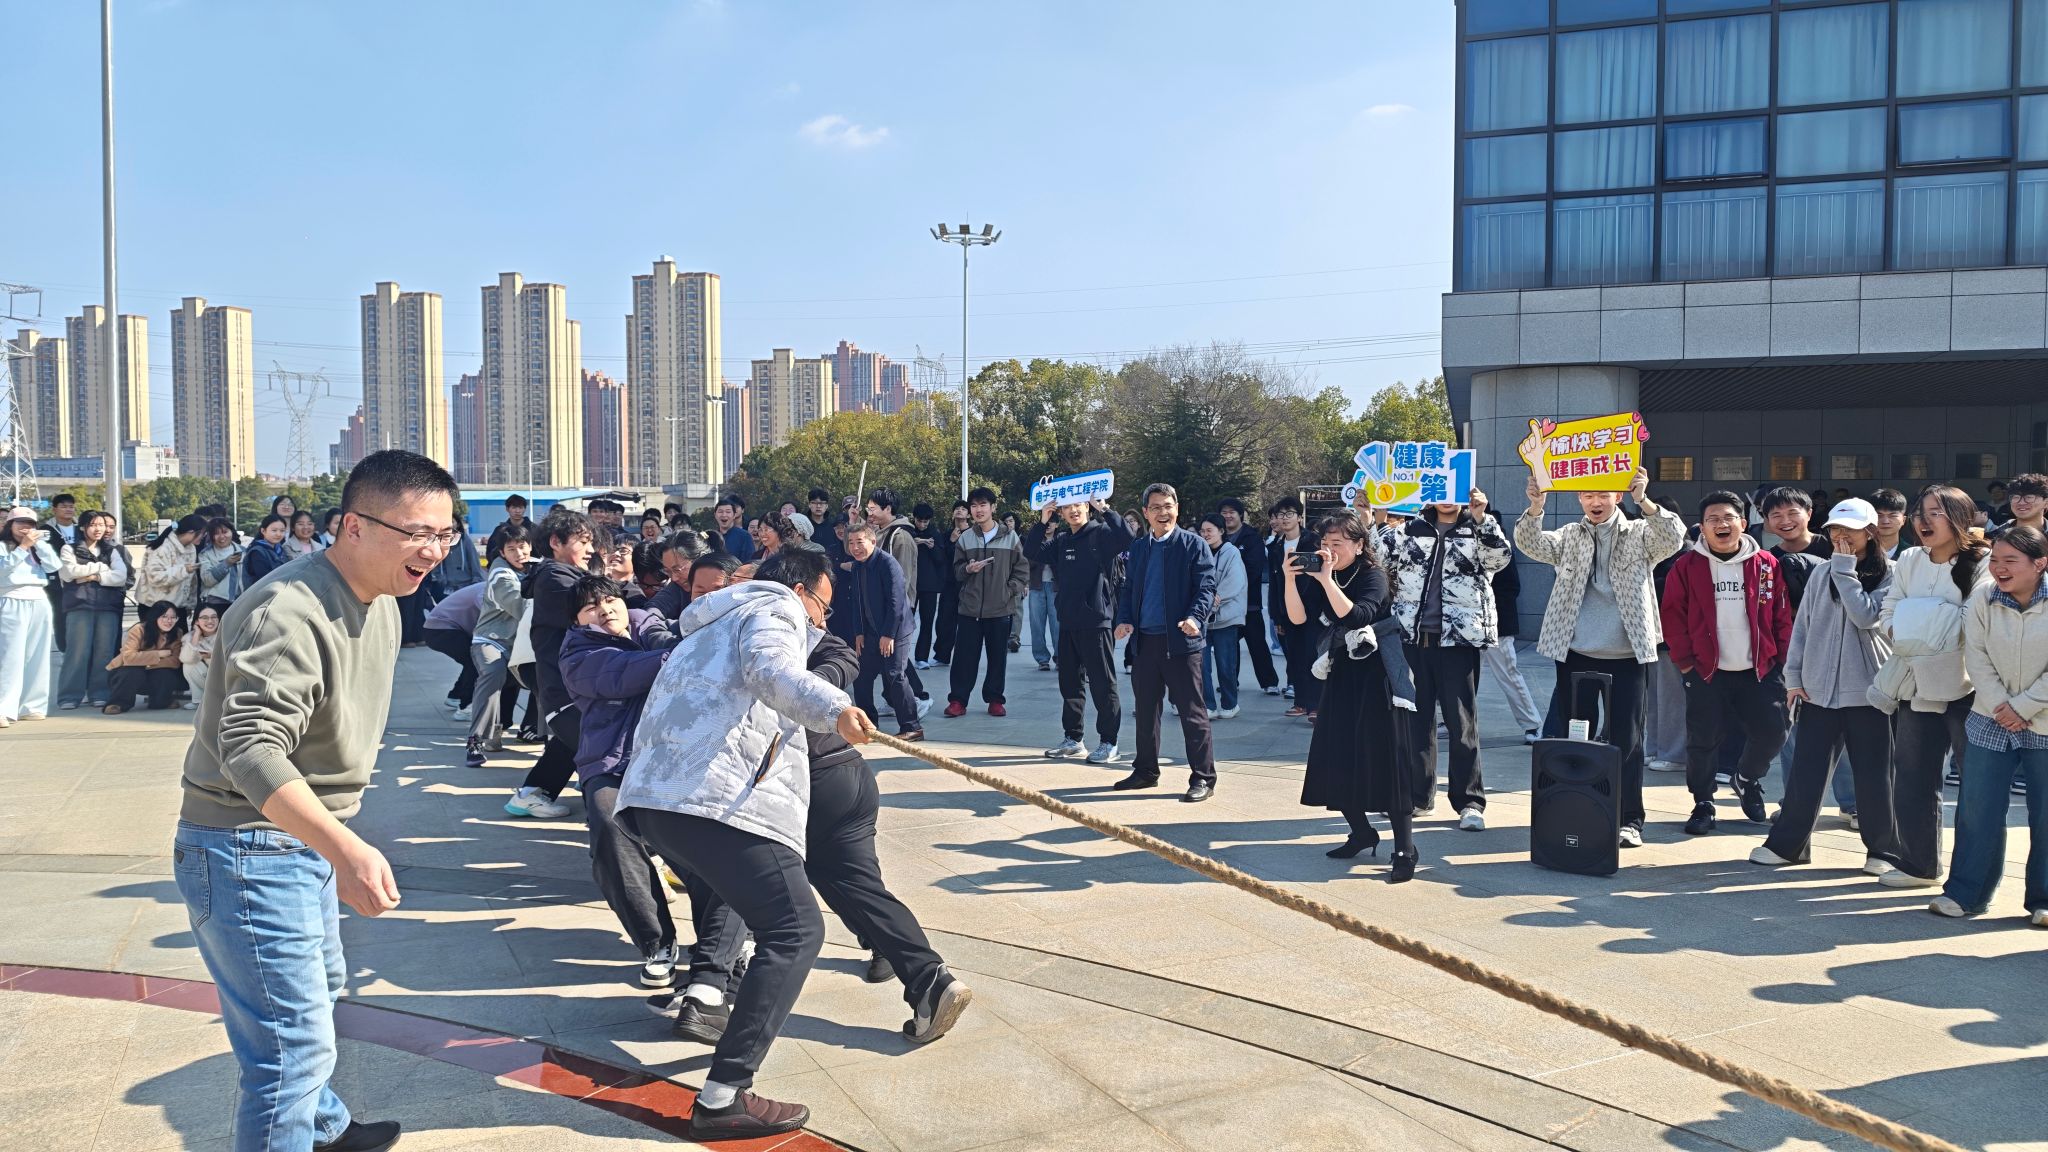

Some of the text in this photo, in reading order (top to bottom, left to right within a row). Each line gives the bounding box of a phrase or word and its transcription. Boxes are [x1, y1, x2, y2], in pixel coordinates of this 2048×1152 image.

[1549, 425, 1633, 456] 愉快学习
[1392, 442, 1446, 469] 健康
[1550, 453, 1632, 479] 健康成长
[1393, 472, 1414, 481] NO.1
[1035, 478, 1109, 503] 电子与电气工程学院
